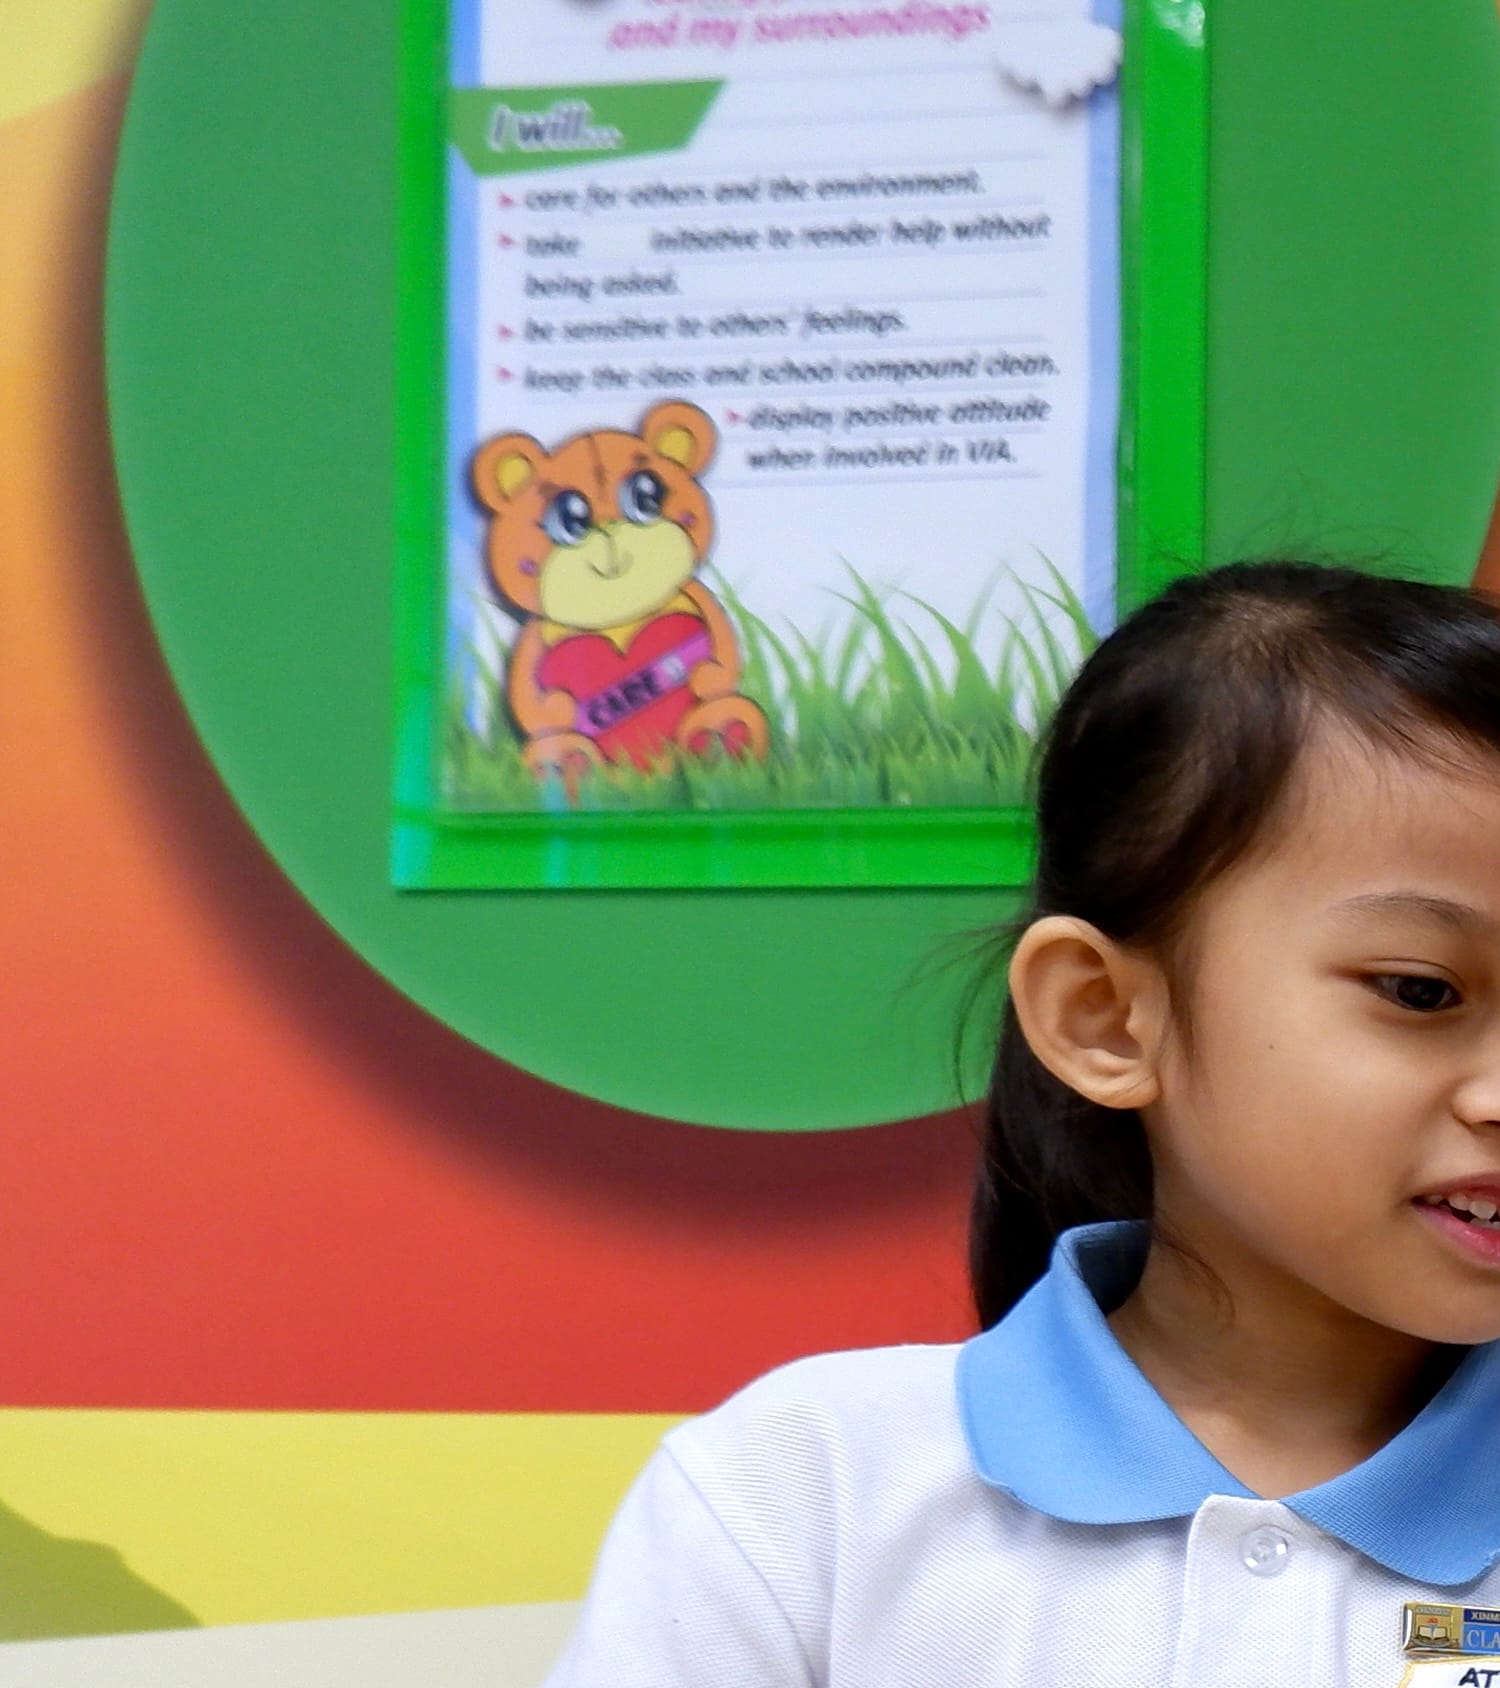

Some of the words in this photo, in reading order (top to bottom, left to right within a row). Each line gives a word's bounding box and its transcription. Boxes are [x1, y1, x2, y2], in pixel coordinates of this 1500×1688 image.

[608, 14, 680, 49] and
[688, 17, 738, 49] my
[491, 104, 509, 150] I
[525, 187, 578, 210] care
[584, 182, 617, 214] for
[629, 180, 706, 207] others
[714, 177, 759, 204] and
[768, 174, 810, 202] the
[815, 170, 986, 201] environment.
[525, 232, 580, 258] take
[651, 227, 759, 252] initiative
[766, 226, 794, 248] to
[803, 219, 878, 247] render
[889, 217, 946, 249] help
[952, 212, 1052, 242] without
[524, 274, 593, 303] being
[524, 317, 553, 343] be
[562, 316, 668, 342] sensitive
[675, 315, 702, 338] to
[523, 366, 586, 394] keep
[590, 366, 630, 390] the
[638, 361, 697, 388] class
[702, 358, 752, 386] and
[758, 356, 838, 385] school
[845, 351, 980, 386] compound
[746, 404, 834, 433] display
[841, 399, 943, 432] positive
[949, 394, 1052, 424] attitude
[746, 447, 815, 471] when
[823, 441, 932, 469] involved
[937, 441, 960, 464] in
